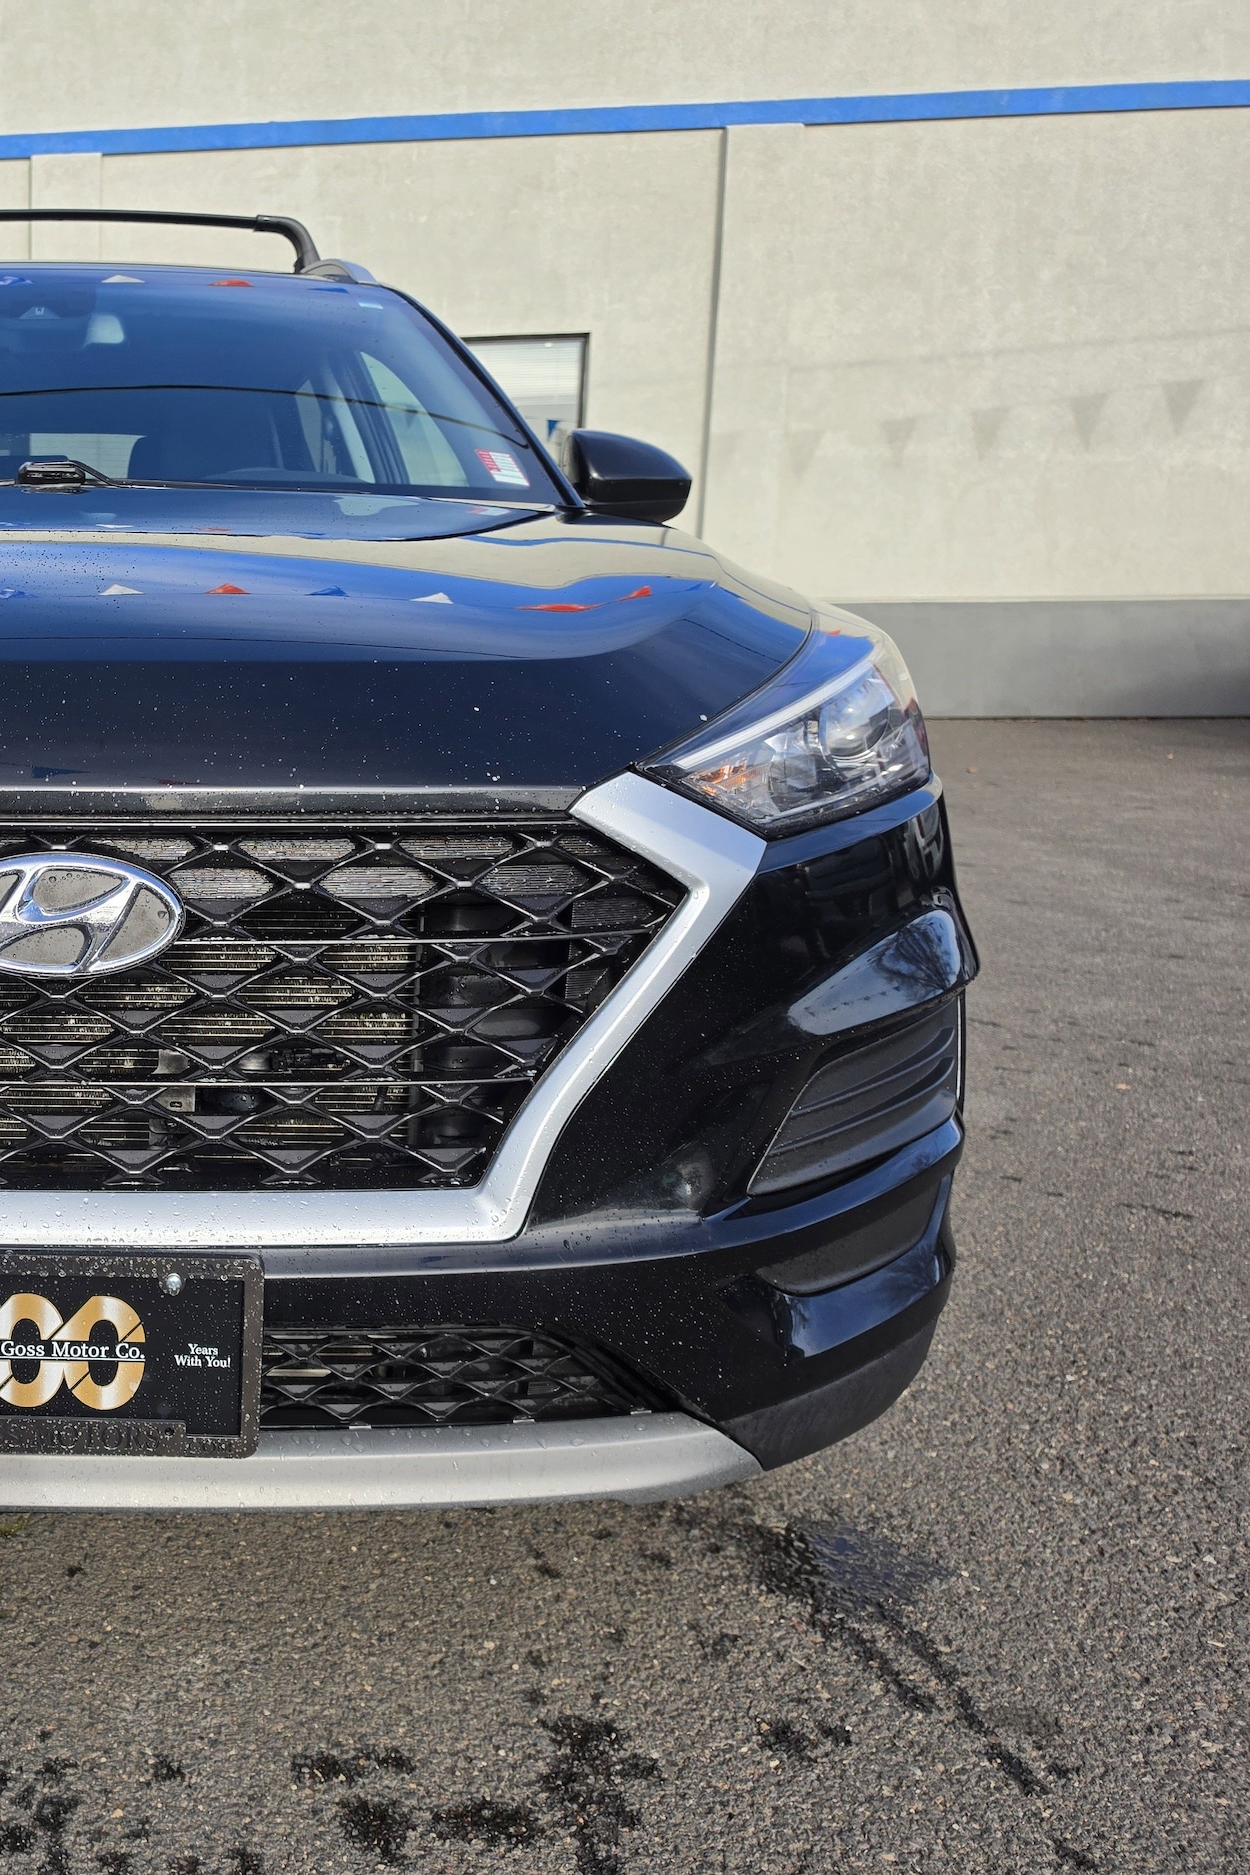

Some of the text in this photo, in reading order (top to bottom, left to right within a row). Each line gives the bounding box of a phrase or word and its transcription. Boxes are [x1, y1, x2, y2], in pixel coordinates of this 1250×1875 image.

[0, 1340, 46, 1357] Goss
[51, 1341, 110, 1359] Motor
[115, 1342, 146, 1360] Co.
[187, 1343, 219, 1356] Years
[174, 1354, 231, 1368] With You!
